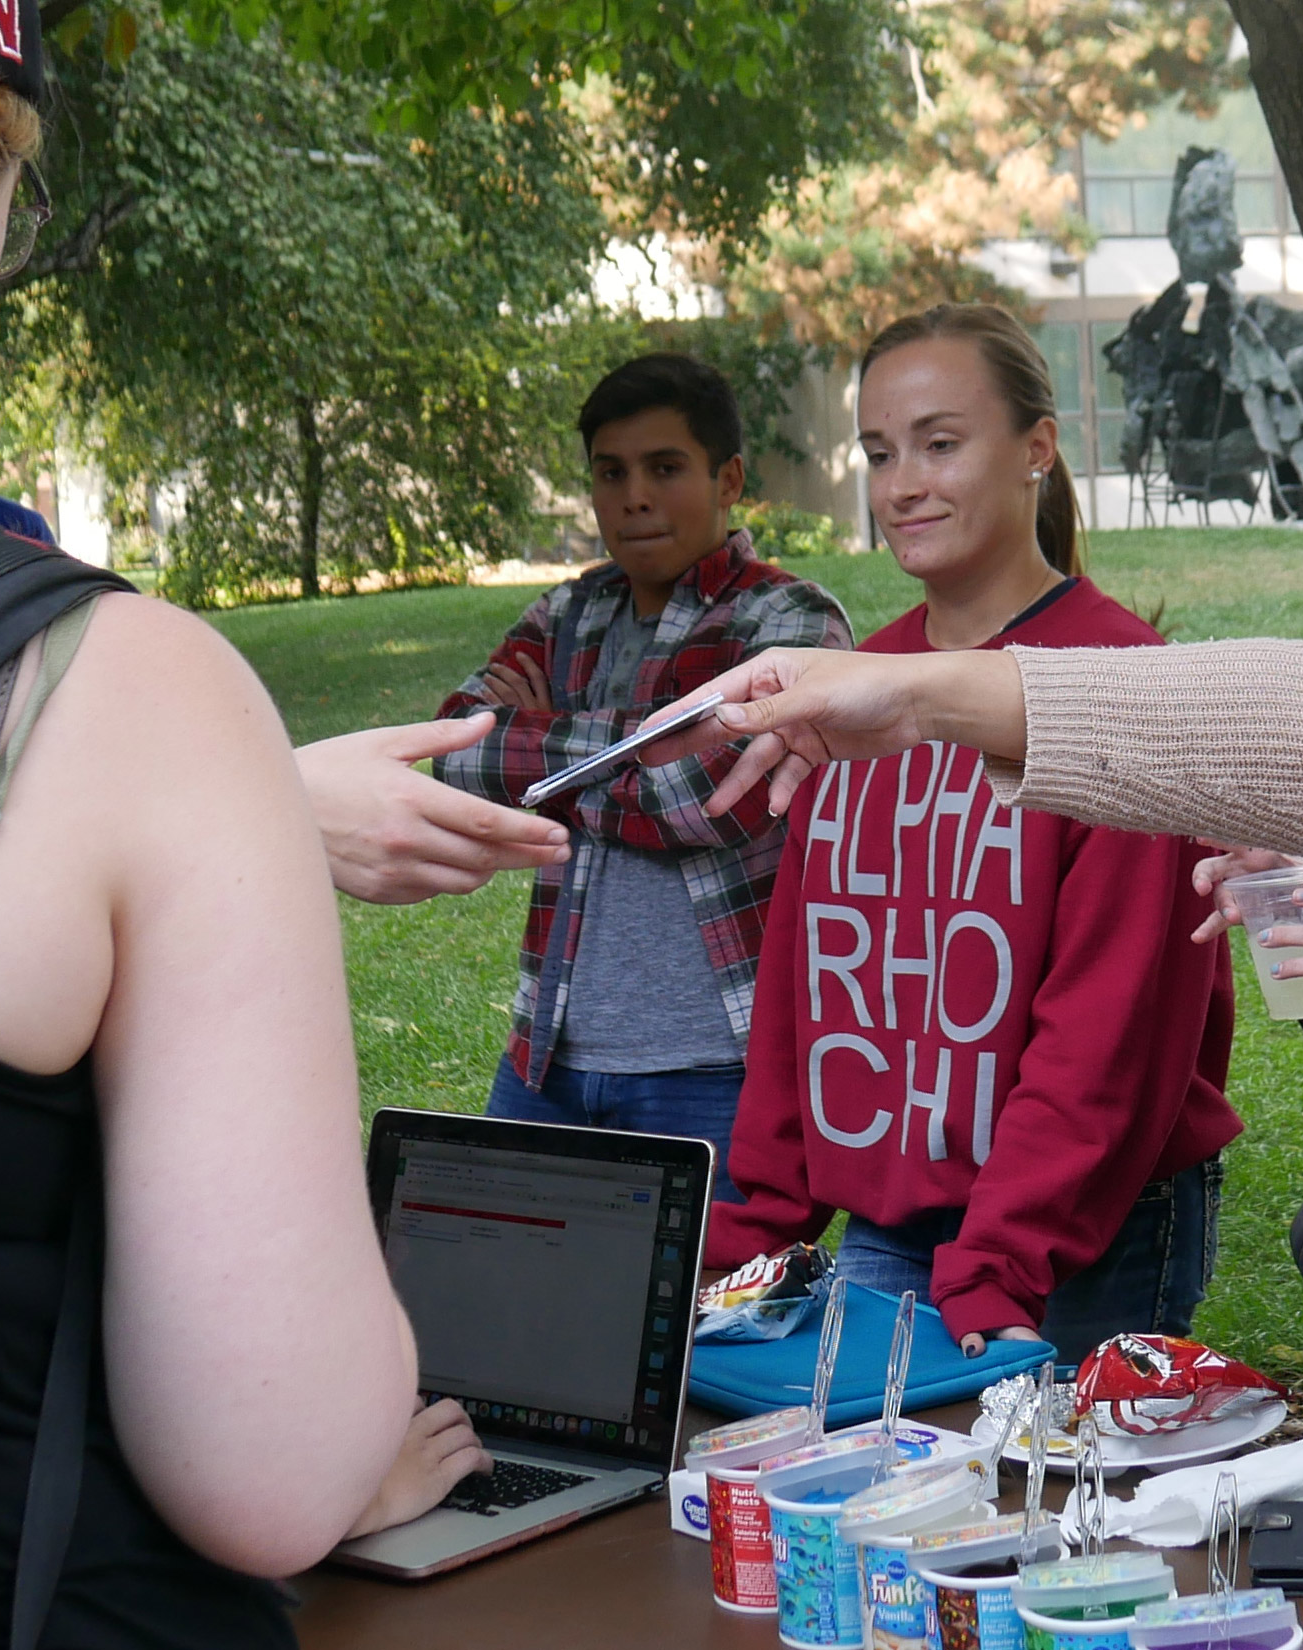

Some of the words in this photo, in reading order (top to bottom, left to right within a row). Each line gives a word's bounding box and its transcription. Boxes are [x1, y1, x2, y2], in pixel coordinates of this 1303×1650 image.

[803, 740, 1023, 905] ALPHA
[805, 902, 1013, 1043] RHO
[809, 1033, 996, 1167] CHI
[732, 1488, 757, 1498] Nutri
[871, 1573, 926, 1606] Funfe
[877, 1607, 915, 1623] Vanilla
